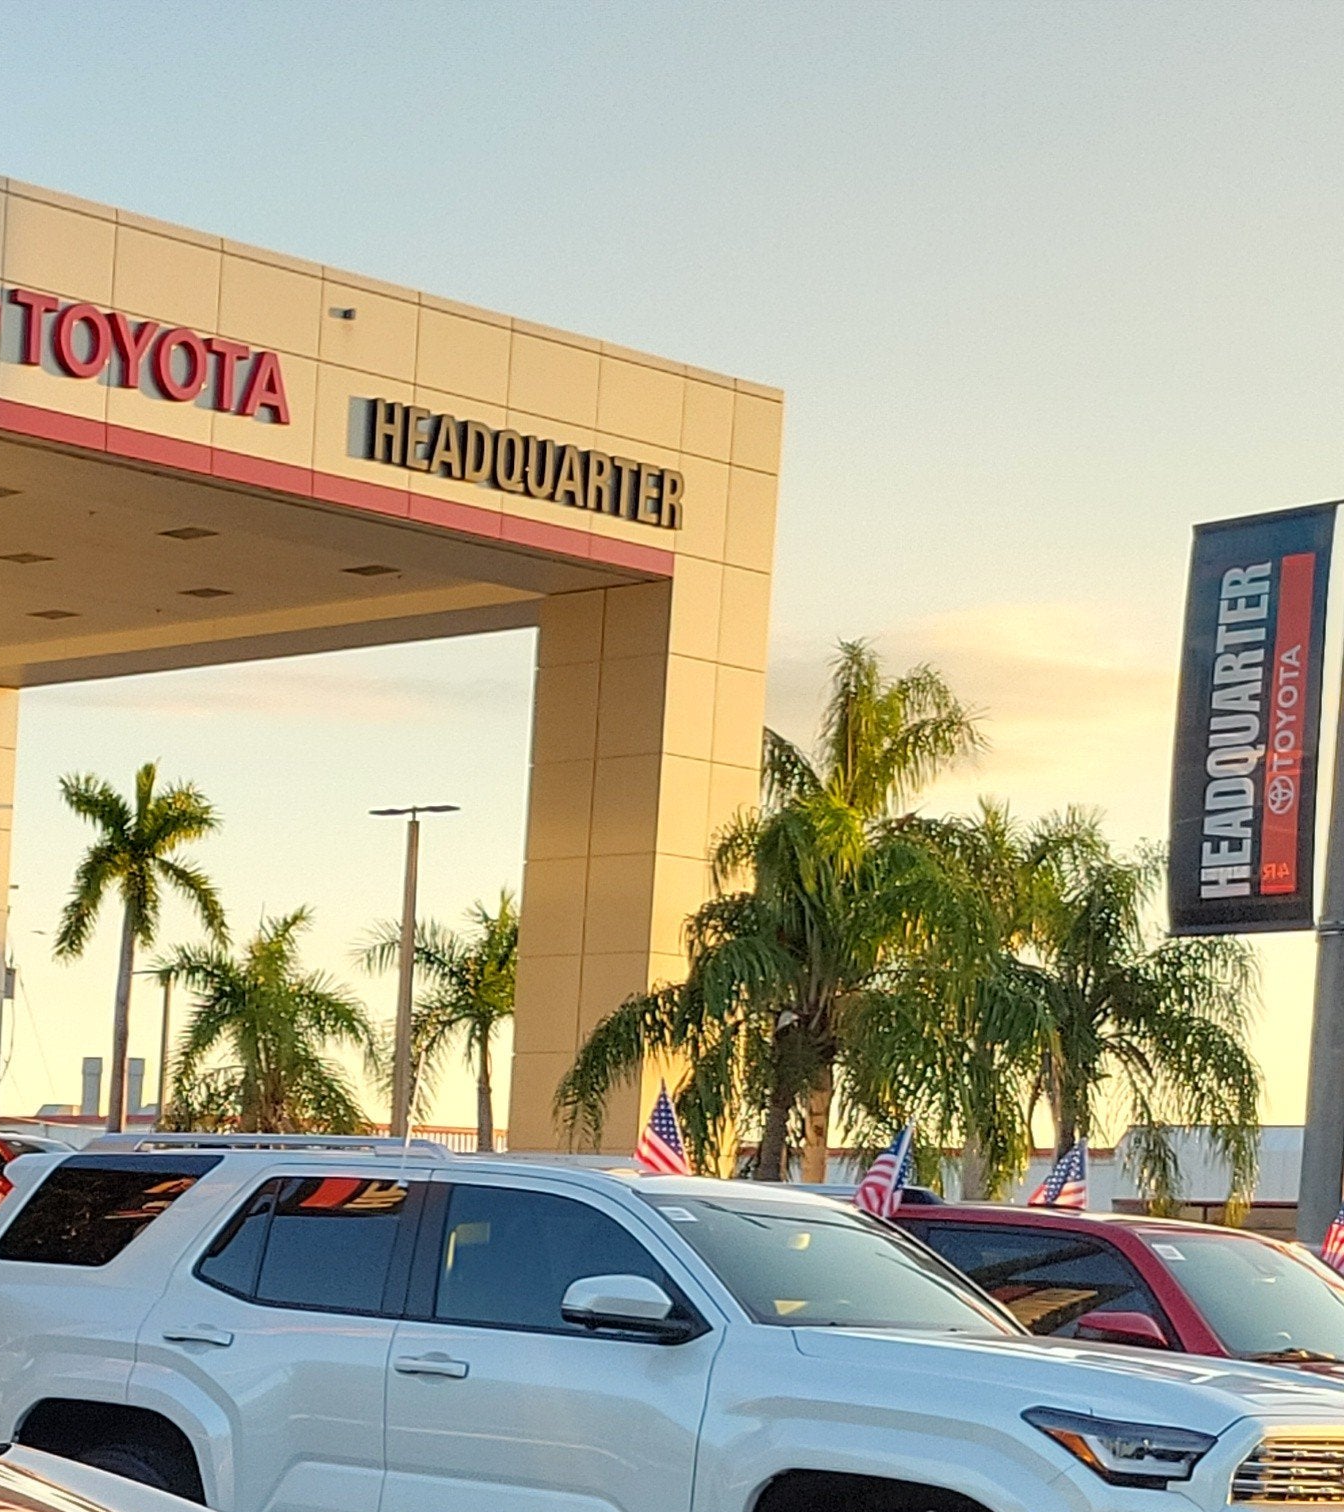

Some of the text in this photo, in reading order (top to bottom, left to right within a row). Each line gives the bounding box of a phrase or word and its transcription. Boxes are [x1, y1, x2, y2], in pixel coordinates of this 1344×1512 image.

[8, 288, 290, 424] TOYOTA
[373, 397, 686, 530] HEADQUARTER
[1201, 562, 1272, 899] HEADQUARTER
[1273, 644, 1301, 772] TOYOTA
